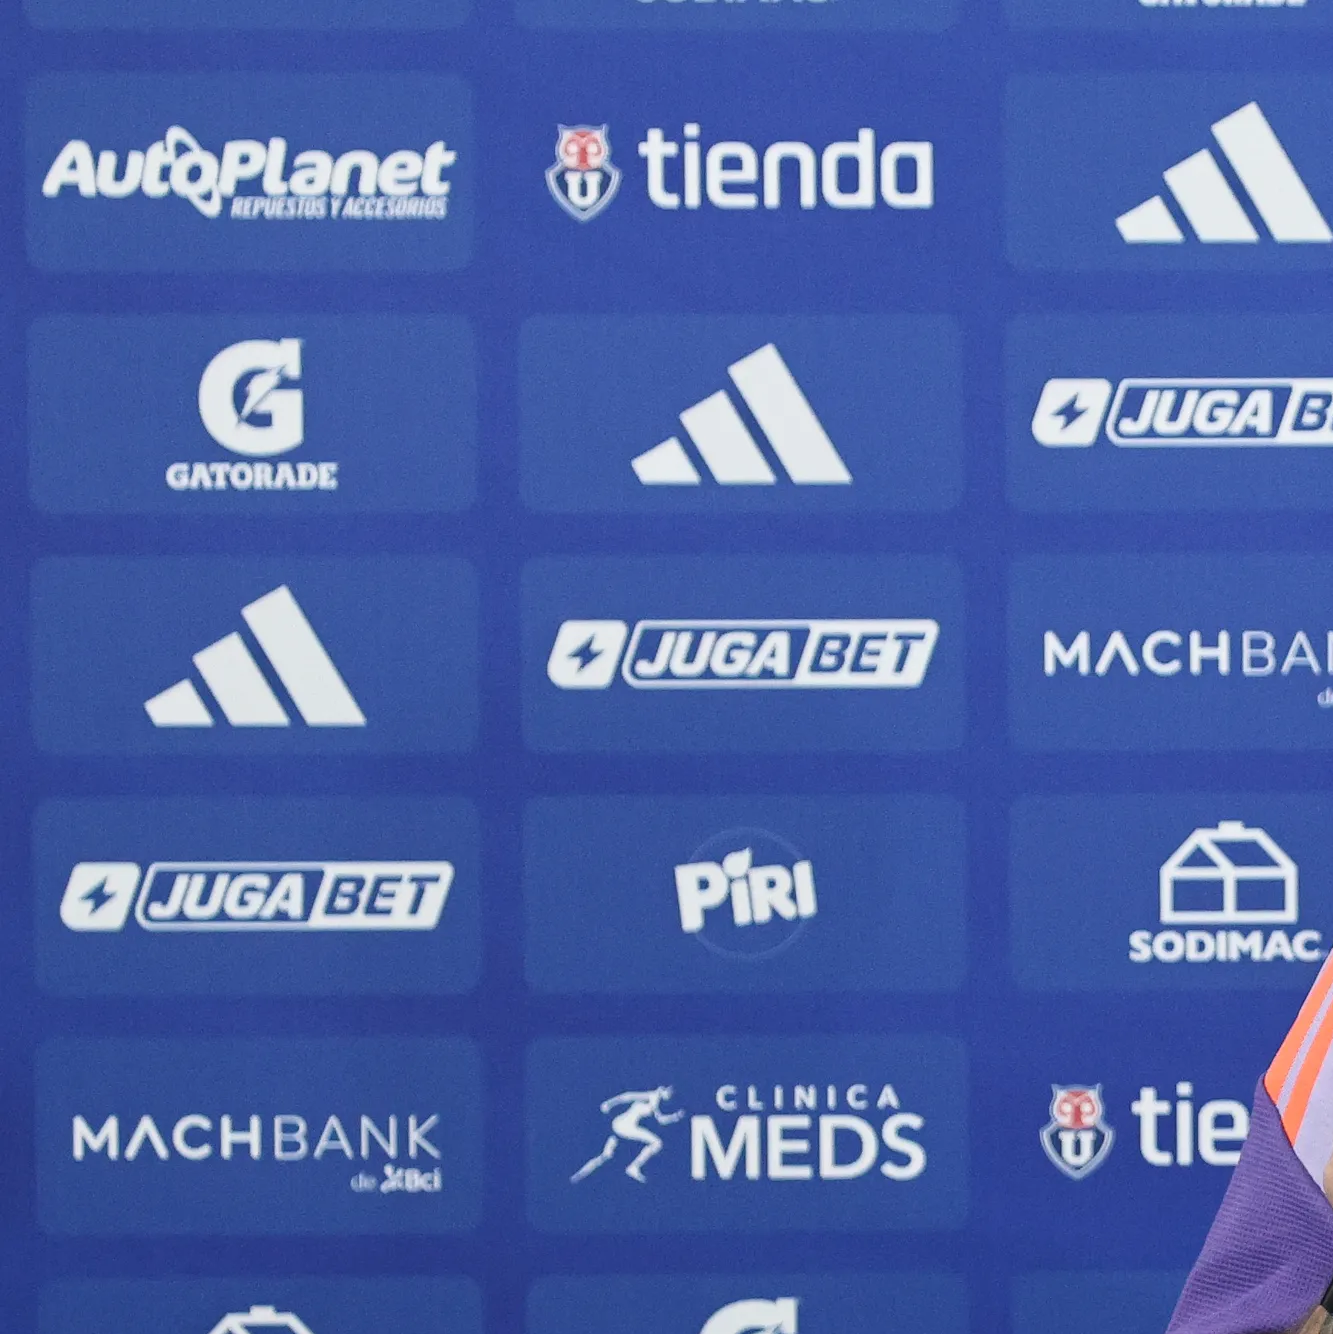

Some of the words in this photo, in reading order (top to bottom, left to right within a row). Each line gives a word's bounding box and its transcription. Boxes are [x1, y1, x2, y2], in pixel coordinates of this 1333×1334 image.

[43, 126, 456, 218] AutoPlanet
[639, 123, 933, 208] tienda
[565, 173, 599, 206] U
[199, 339, 303, 455] G
[166, 463, 337, 489] GATORADE
[1130, 930, 1320, 961] SODIMAC
[716, 1085, 898, 1110] CLINICA
[73, 1115, 439, 1160] MACHBANK
[691, 1113, 925, 1179] MEDS
[1058, 1130, 1097, 1163] U
[1131, 1081, 1250, 1167] tie
